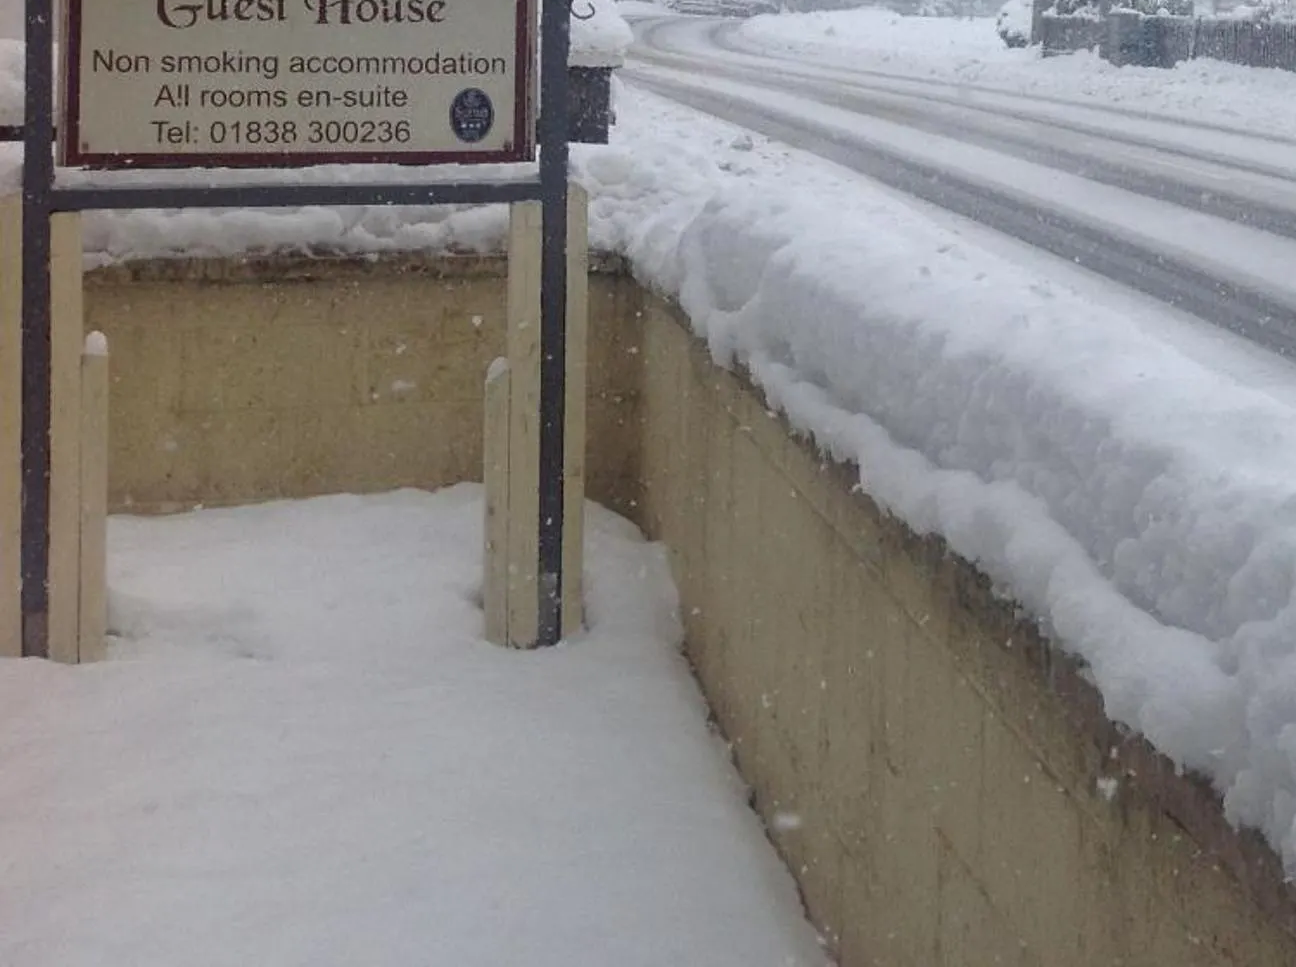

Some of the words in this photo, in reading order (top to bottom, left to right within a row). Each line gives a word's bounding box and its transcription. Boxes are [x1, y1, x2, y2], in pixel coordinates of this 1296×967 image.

[93, 48, 149, 74] Non
[160, 50, 278, 79] smoking
[288, 52, 506, 75] accommodation
[154, 85, 190, 108] All
[201, 88, 287, 108] rooms
[298, 87, 408, 108] en-suite
[151, 120, 198, 144] Tel:
[209, 120, 297, 144] 01838
[307, 121, 410, 144] 300236
